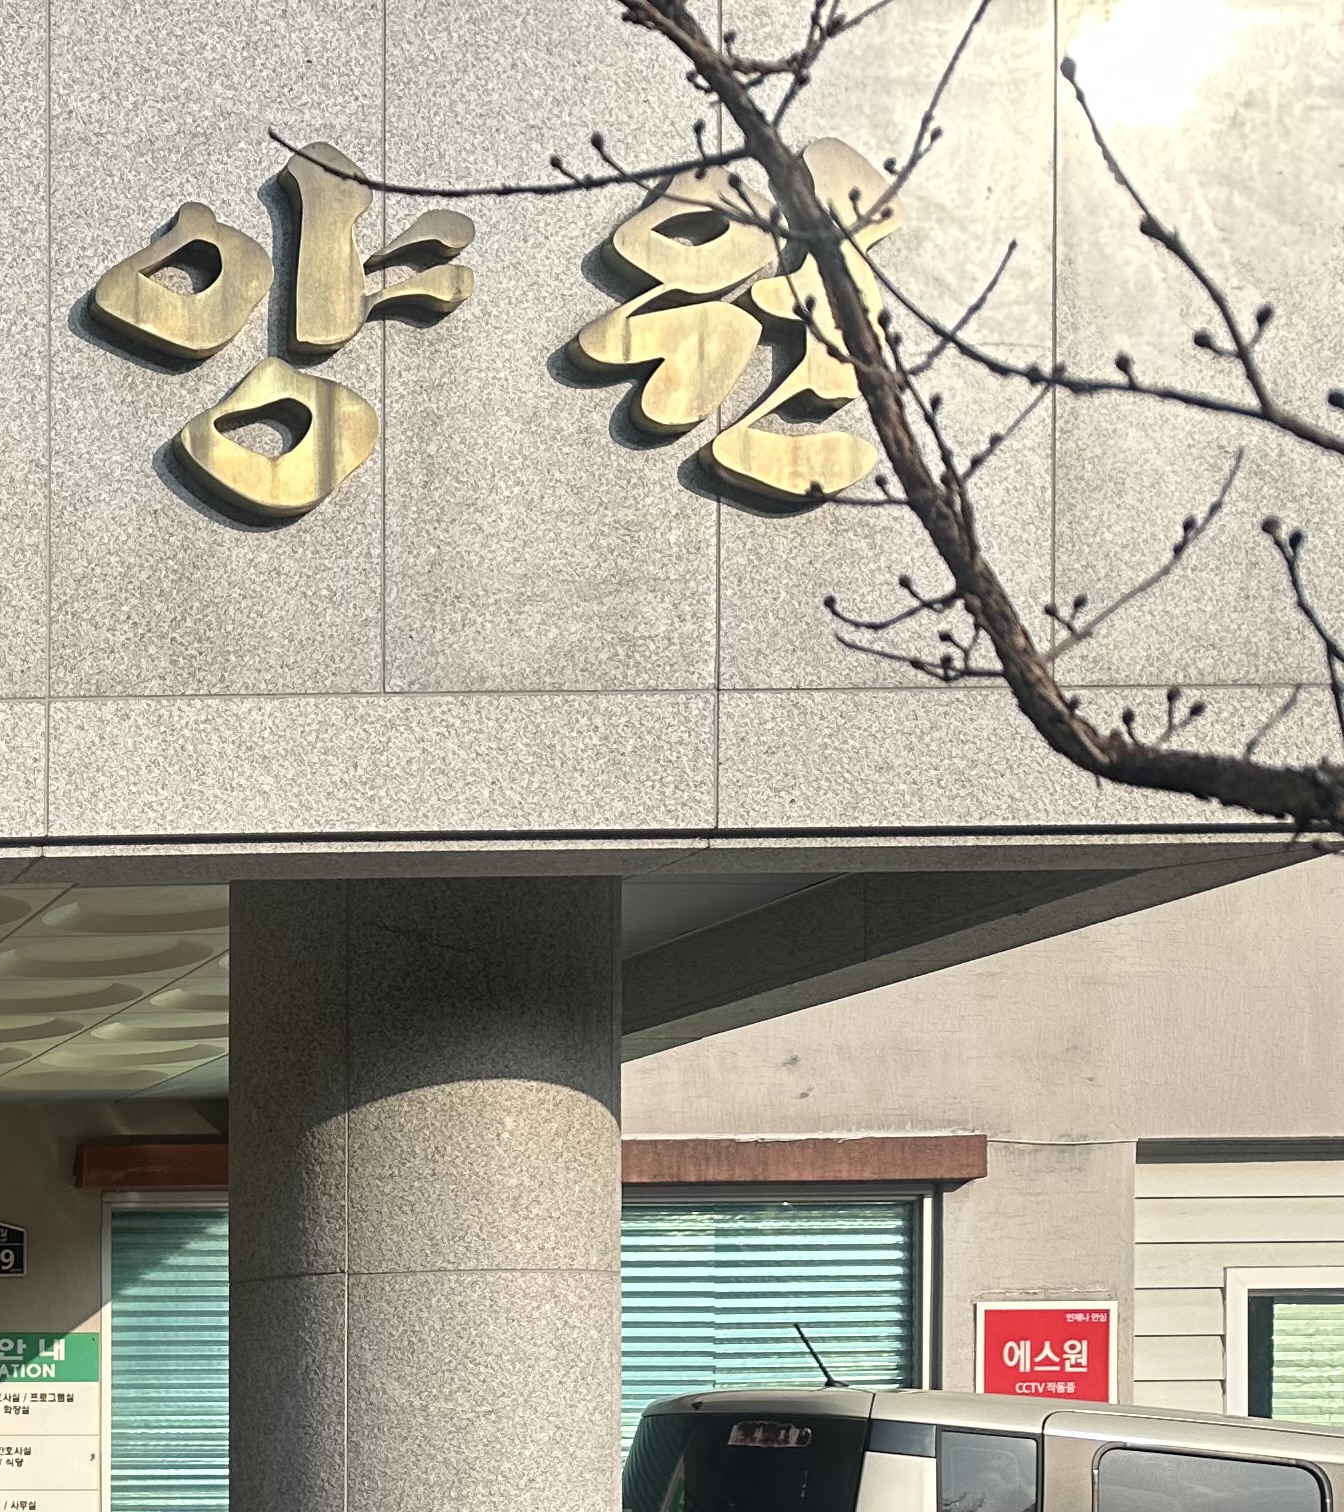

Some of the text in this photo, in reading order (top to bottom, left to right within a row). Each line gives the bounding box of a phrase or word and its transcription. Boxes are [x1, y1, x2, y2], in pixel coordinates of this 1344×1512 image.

[1066, 1313, 1108, 1322] 언제나 안심
[1003, 1339, 1088, 1372] 에스원
[1015, 1382, 1076, 1394] CCTV 작동중
[30, 1393, 74, 1403] 프로그램실
[4, 1405, 29, 1415] 화장실
[5, 1458, 23, 1467] 식당
[11, 1501, 36, 1510] 사무실
